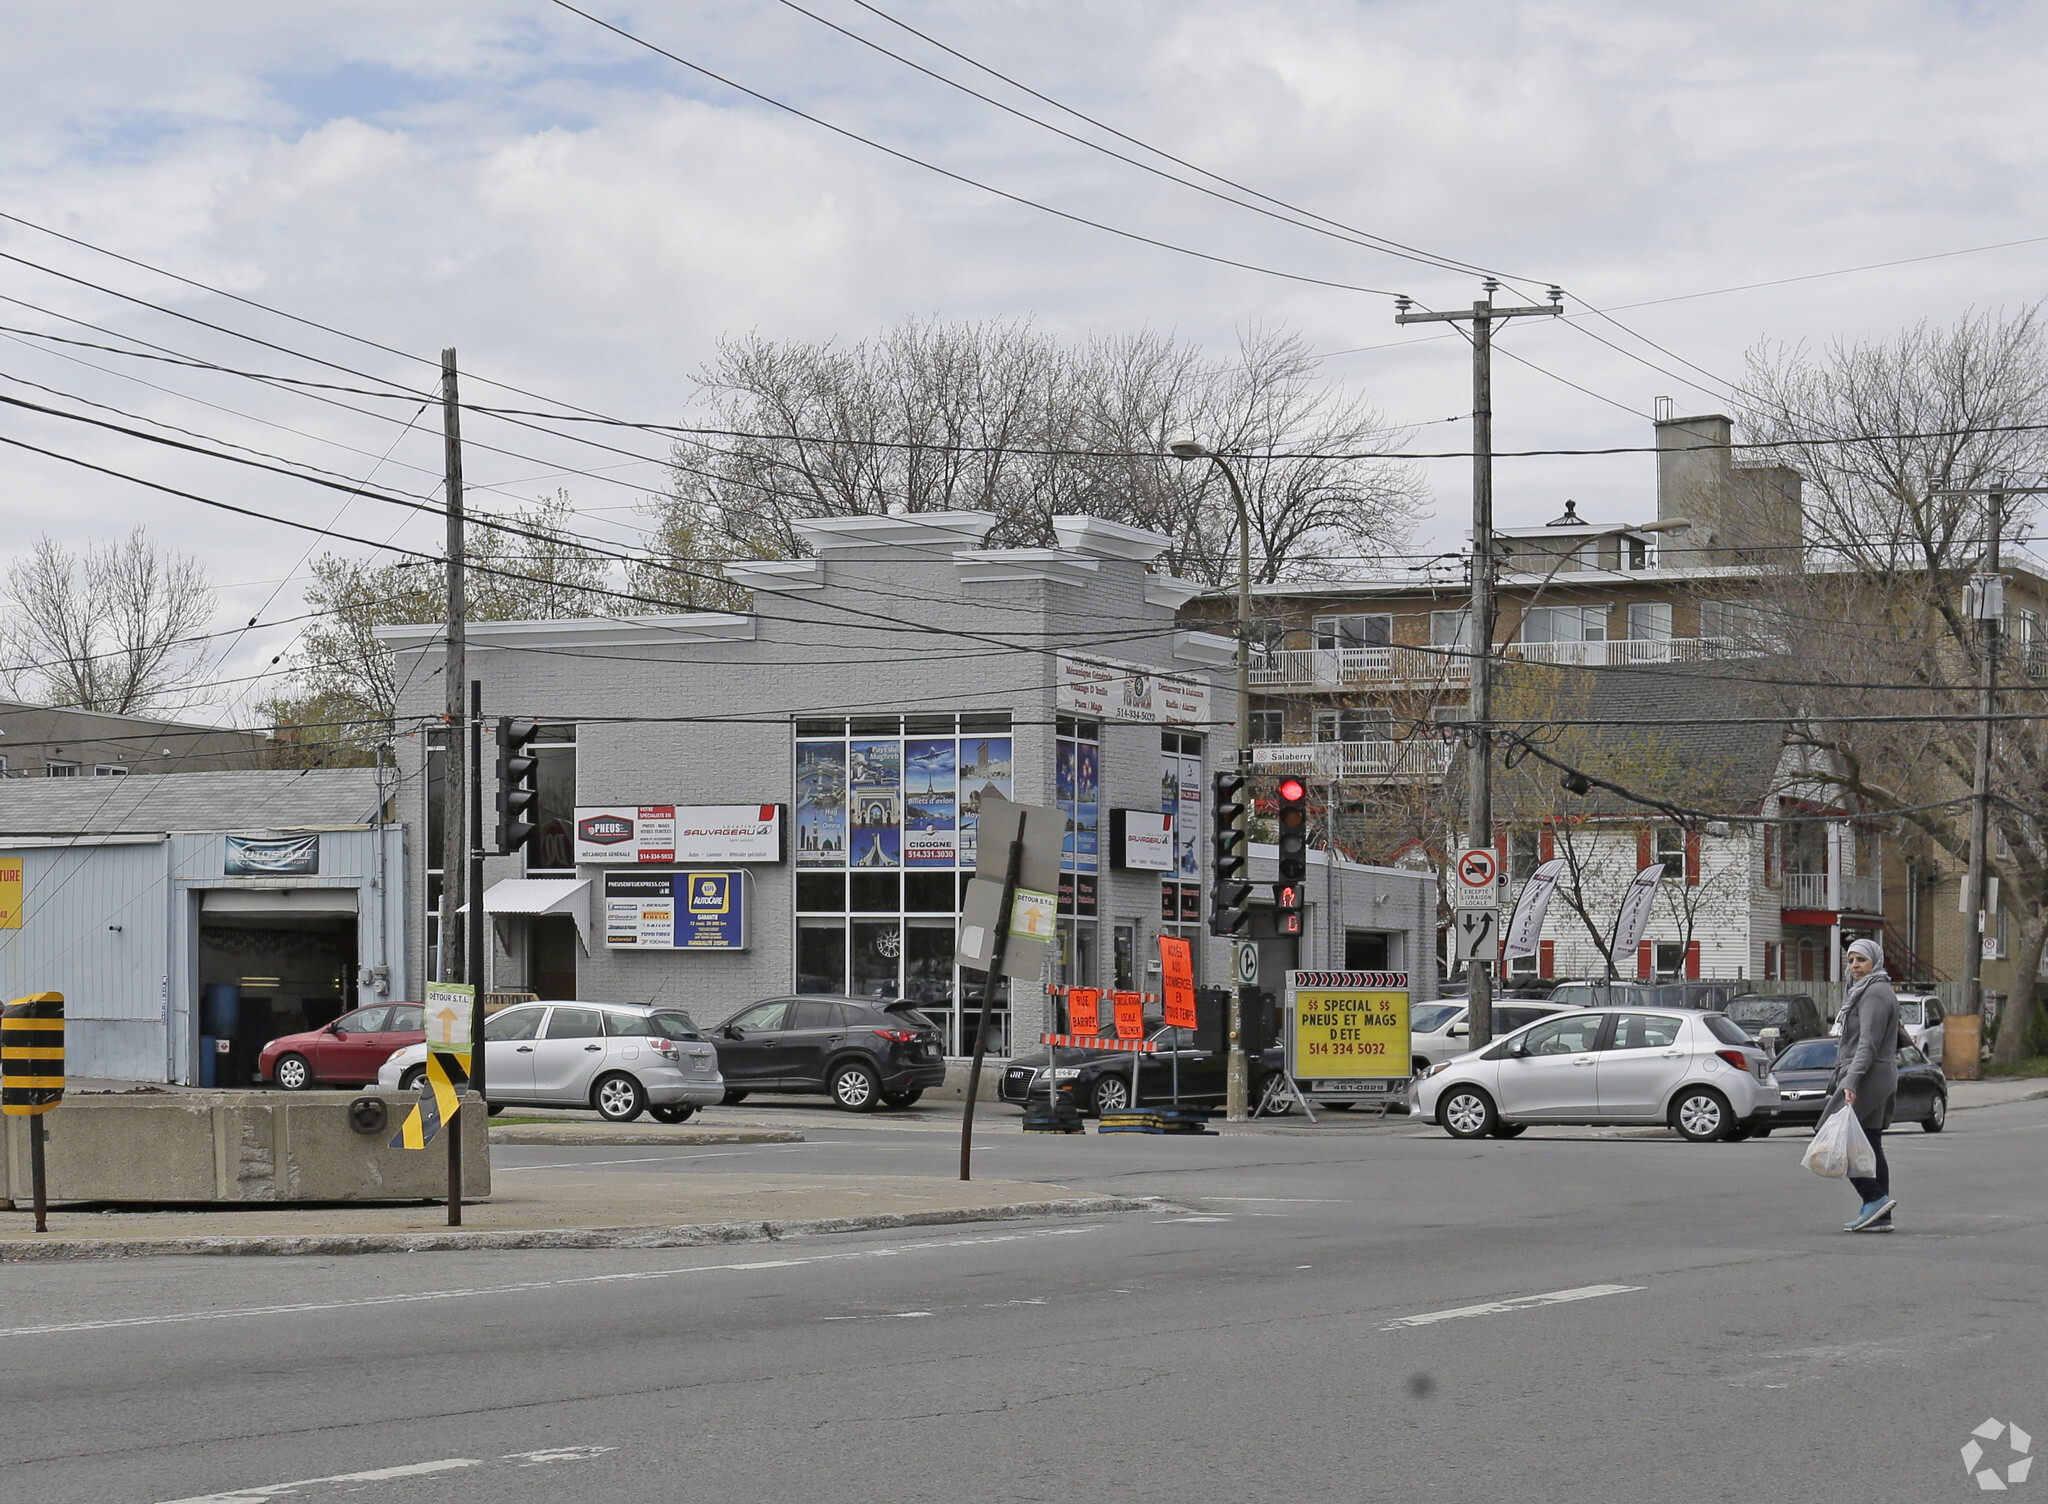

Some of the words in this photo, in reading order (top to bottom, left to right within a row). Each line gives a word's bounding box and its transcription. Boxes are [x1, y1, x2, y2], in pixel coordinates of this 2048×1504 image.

[872, 746, 888, 755] Pays
[869, 752, 899, 762] Maghreb
[1271, 752, 1312, 761] Salaberry
[595, 823, 620, 833] PNEUS
[908, 850, 954, 858] 514.331.3030
[0, 869, 20, 882] TURE
[1017, 894, 1038, 903] DÉTOUR
[1165, 974, 1192, 990] COMMERCES
[429, 992, 451, 1002] DÉTOUR
[1076, 996, 1089, 1006] RUE
[1176, 992, 1182, 1003] EN
[1308, 1000, 1318, 1011] $$
[1324, 1000, 1371, 1011] SPECIAL
[1380, 1000, 1390, 1012] $$
[1121, 1012, 1136, 1022] LOCALE
[1166, 1005, 1179, 1019] TOUS
[1179, 1007, 1194, 1022] TEMPS
[1072, 1016, 1097, 1027] BARRÉE
[1302, 1014, 1338, 1026] PNEUS
[1344, 1014, 1357, 1026] ET
[1364, 1014, 1396, 1026] MAGS
[1309, 1043, 1328, 1055] 514
[1333, 1043, 1353, 1055] 334
[1357, 1043, 1385, 1055] 5032
